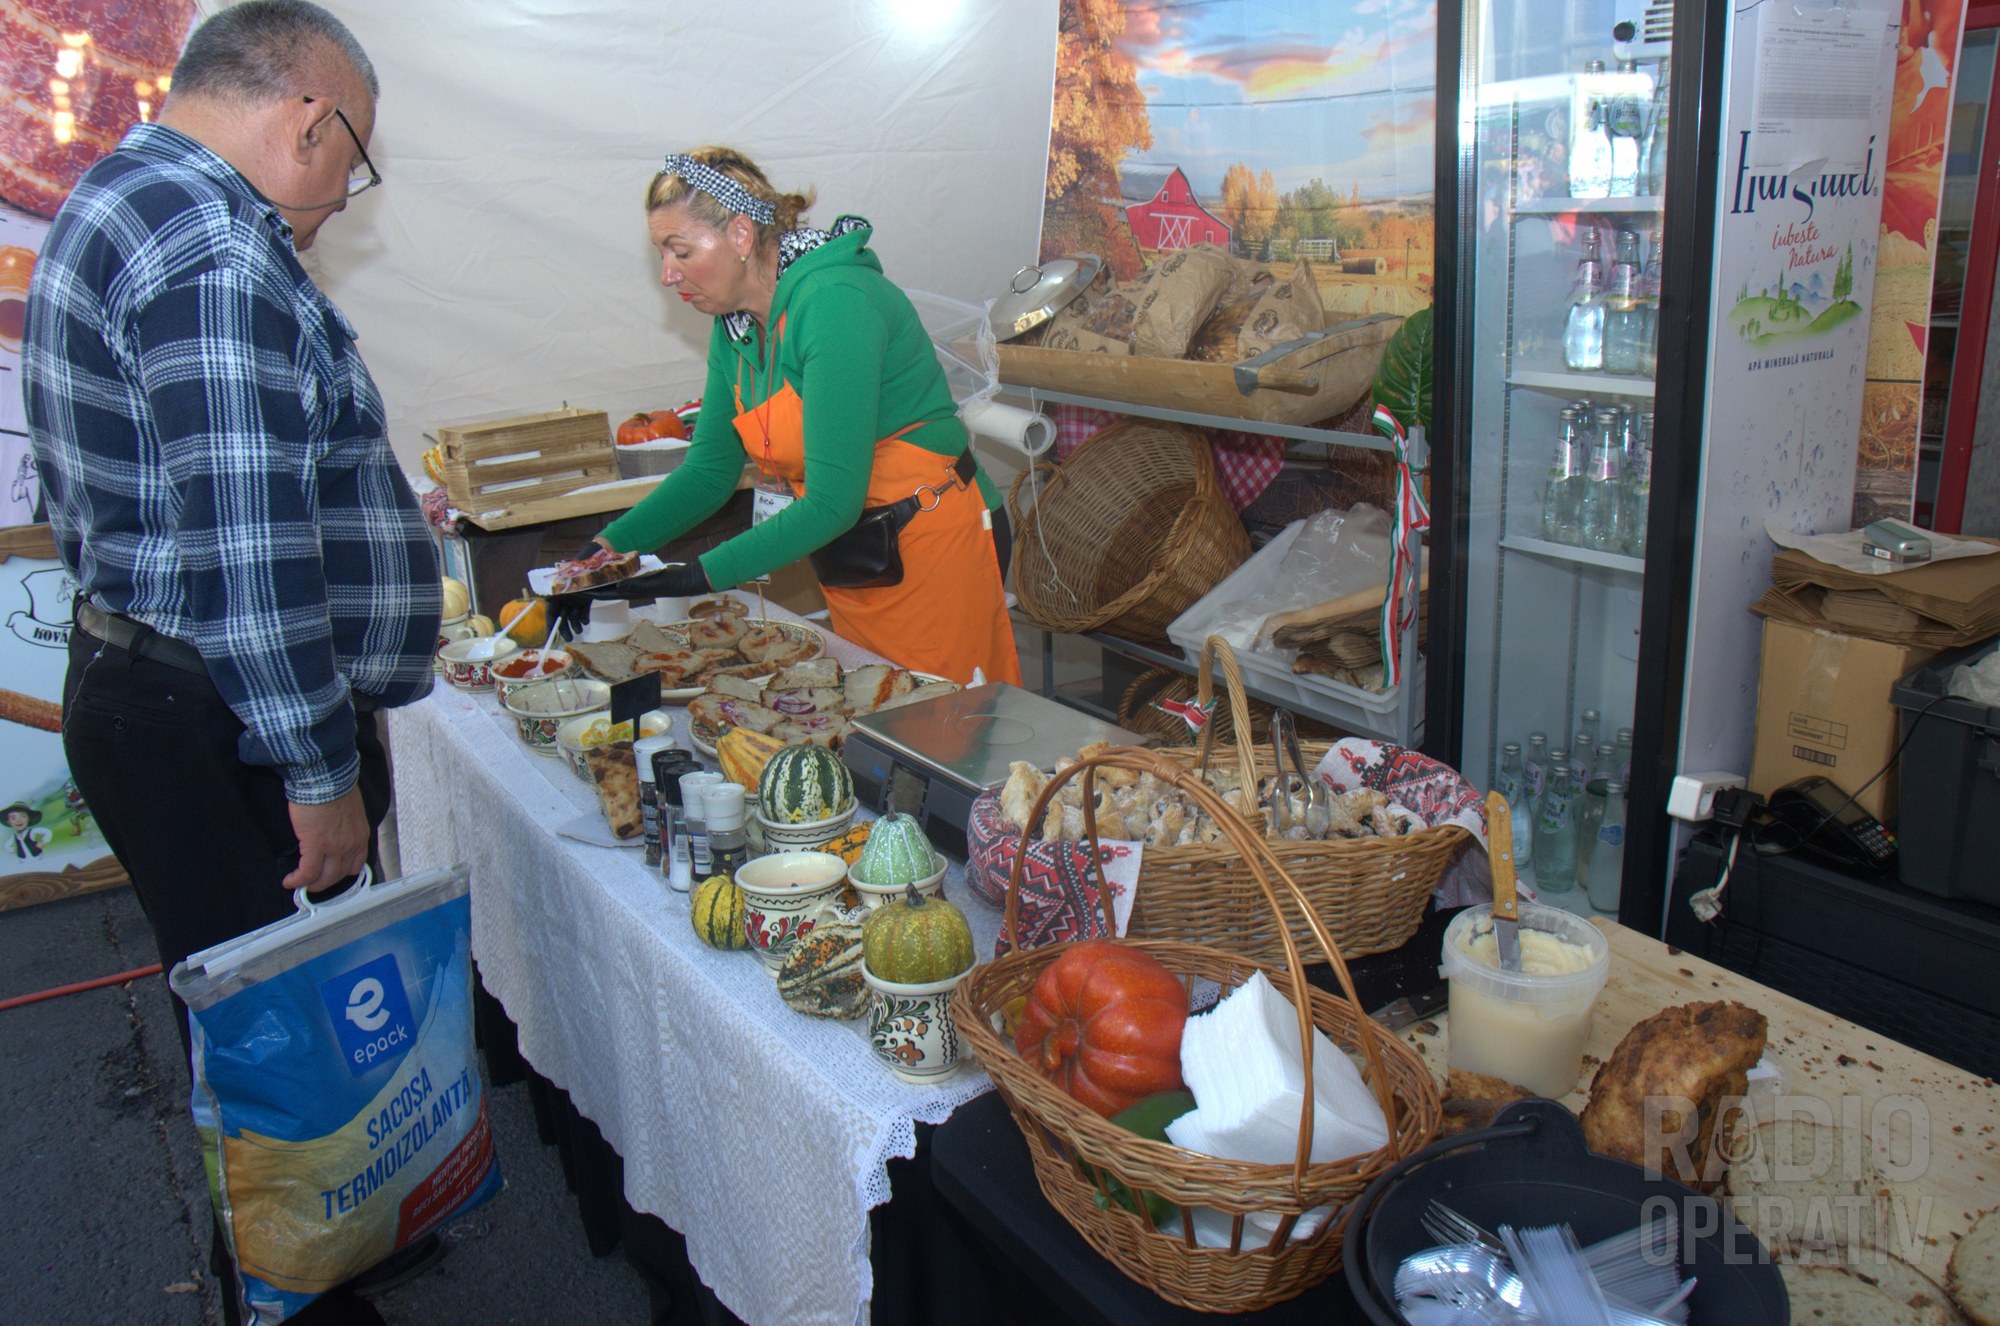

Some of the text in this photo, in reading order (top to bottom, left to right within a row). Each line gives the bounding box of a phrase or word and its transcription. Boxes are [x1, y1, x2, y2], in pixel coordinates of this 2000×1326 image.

[353, 1024, 408, 1064] epack
[320, 1066, 471, 1220] TERMOIZOLANTĂ
[366, 1066, 433, 1152] SACOȘA
